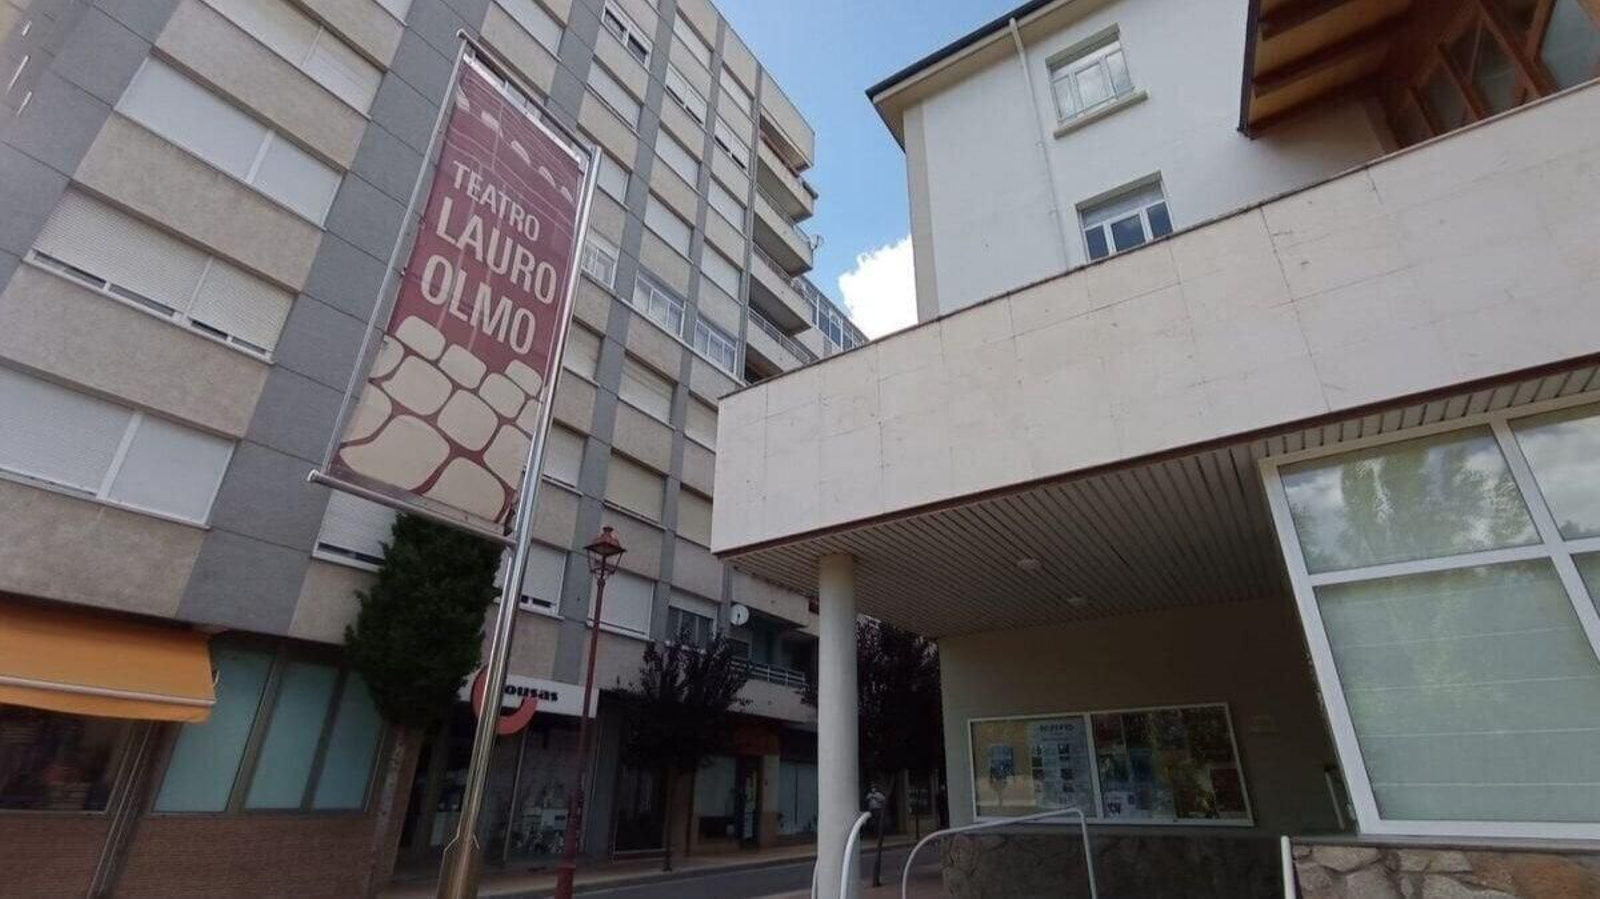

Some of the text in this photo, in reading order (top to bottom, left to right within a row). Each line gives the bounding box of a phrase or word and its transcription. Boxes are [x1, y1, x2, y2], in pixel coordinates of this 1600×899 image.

[437, 197, 557, 304] LAURO
[454, 161, 540, 242] TEATRO
[421, 254, 536, 355] OLMO
